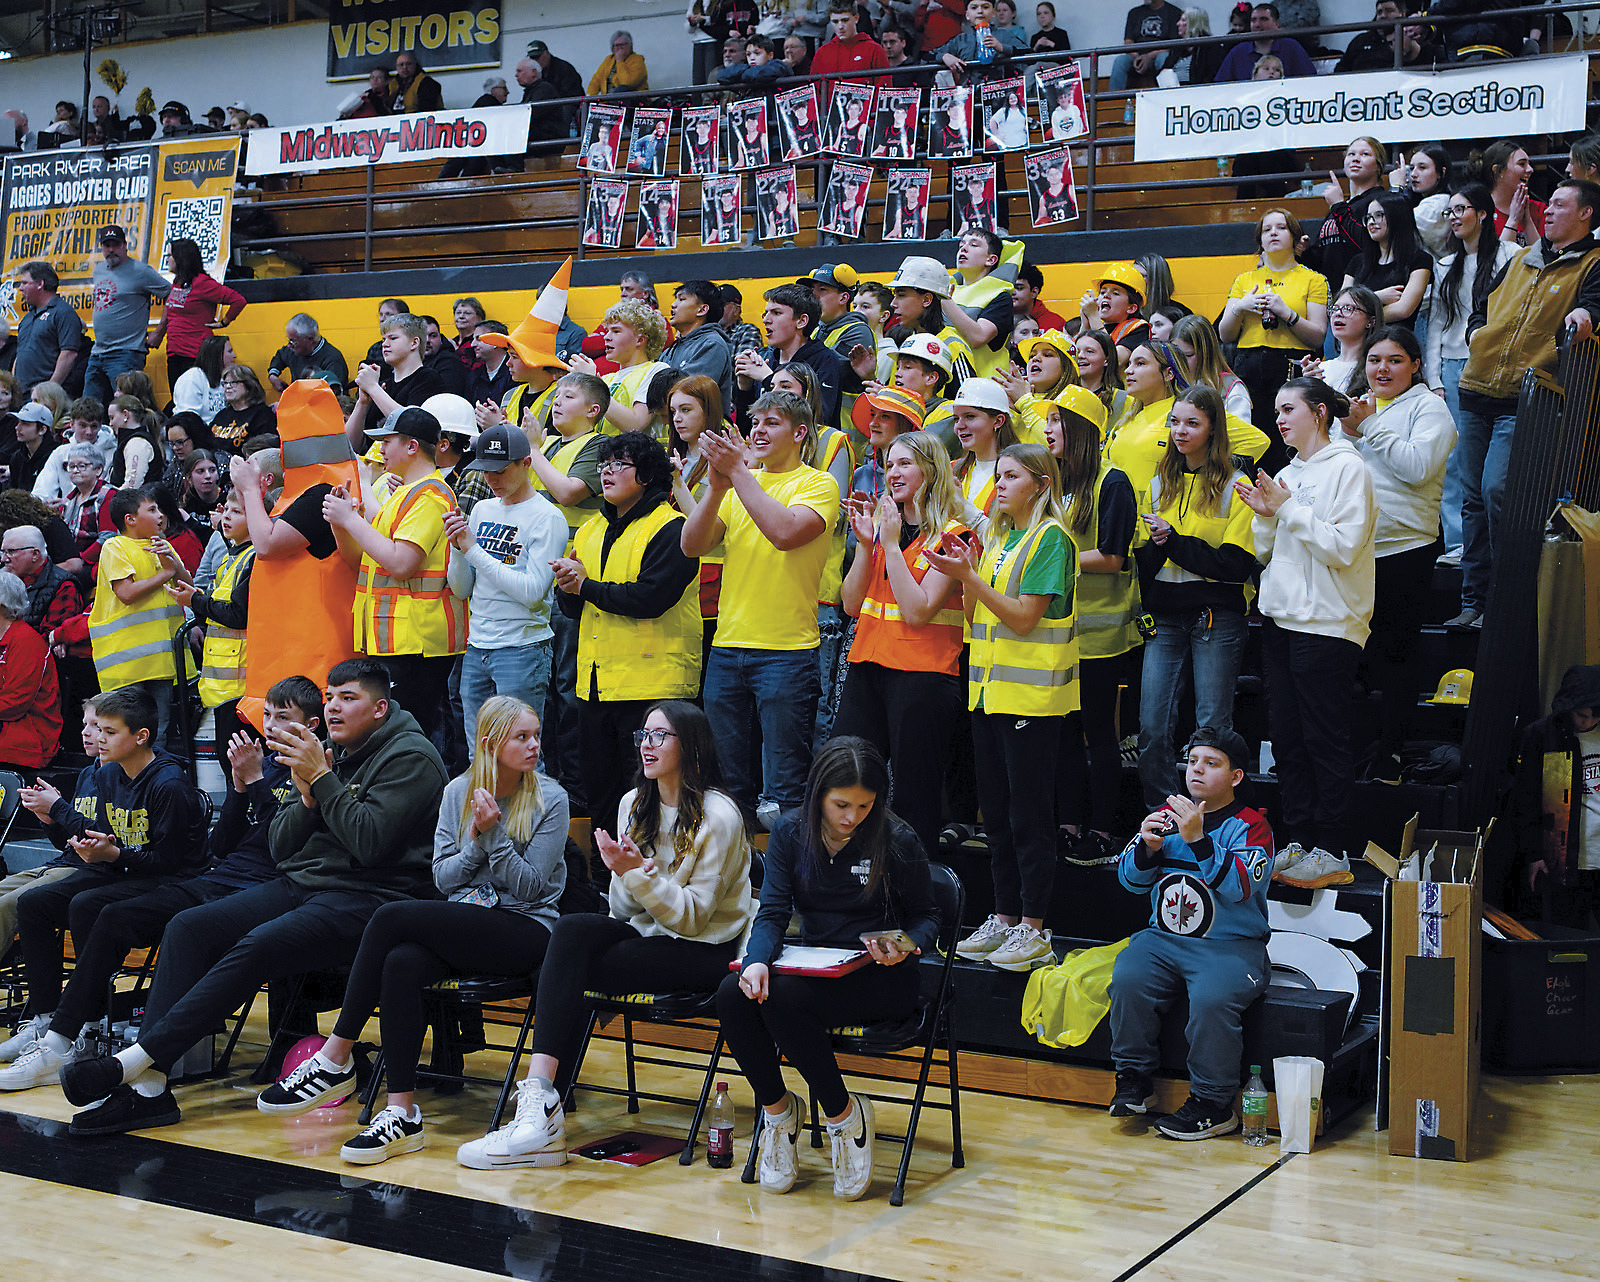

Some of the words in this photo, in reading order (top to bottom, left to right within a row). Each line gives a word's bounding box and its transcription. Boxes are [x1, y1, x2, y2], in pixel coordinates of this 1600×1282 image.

[331, 8, 500, 58] VISITORS
[982, 79, 1025, 93] MUSTANGS
[982, 90, 1006, 101] STATS
[1165, 105, 1261, 136] Home
[1265, 91, 1403, 127] Student
[1408, 81, 1544, 117] Section
[634, 118, 655, 126] STATS
[685, 115, 697, 132] 2
[731, 110, 744, 127] 3
[280, 116, 487, 164] Midway-Minto
[803, 140, 810, 152] 4
[840, 140, 849, 152] 5
[888, 146, 899, 157] 10
[1026, 149, 1069, 166] MUSTANGS
[12, 162, 51, 180] PARK
[55, 158, 102, 178] RIVER
[107, 154, 151, 172] AREA
[173, 160, 205, 175] SCAN
[208, 157, 227, 172] ME
[748, 155, 756, 167] 3
[757, 167, 795, 180] MUSTANGS
[9, 183, 52, 209] AGGIES
[54, 177, 112, 205] BOOSTER
[115, 175, 150, 200] CLUB
[758, 177, 779, 195] 22
[641, 190, 660, 204] 14
[14, 213, 51, 231] PROUD
[54, 207, 121, 228] SUPPORTER
[125, 206, 141, 223] OF
[1051, 208, 1066, 221] 33
[721, 228, 730, 241] 15
[776, 224, 787, 236] 22
[903, 225, 914, 238] 24
[602, 232, 612, 244] 13
[9, 231, 53, 260] AGGIE
[488, 440, 502, 450] JB
[476, 520, 519, 542] STATE
